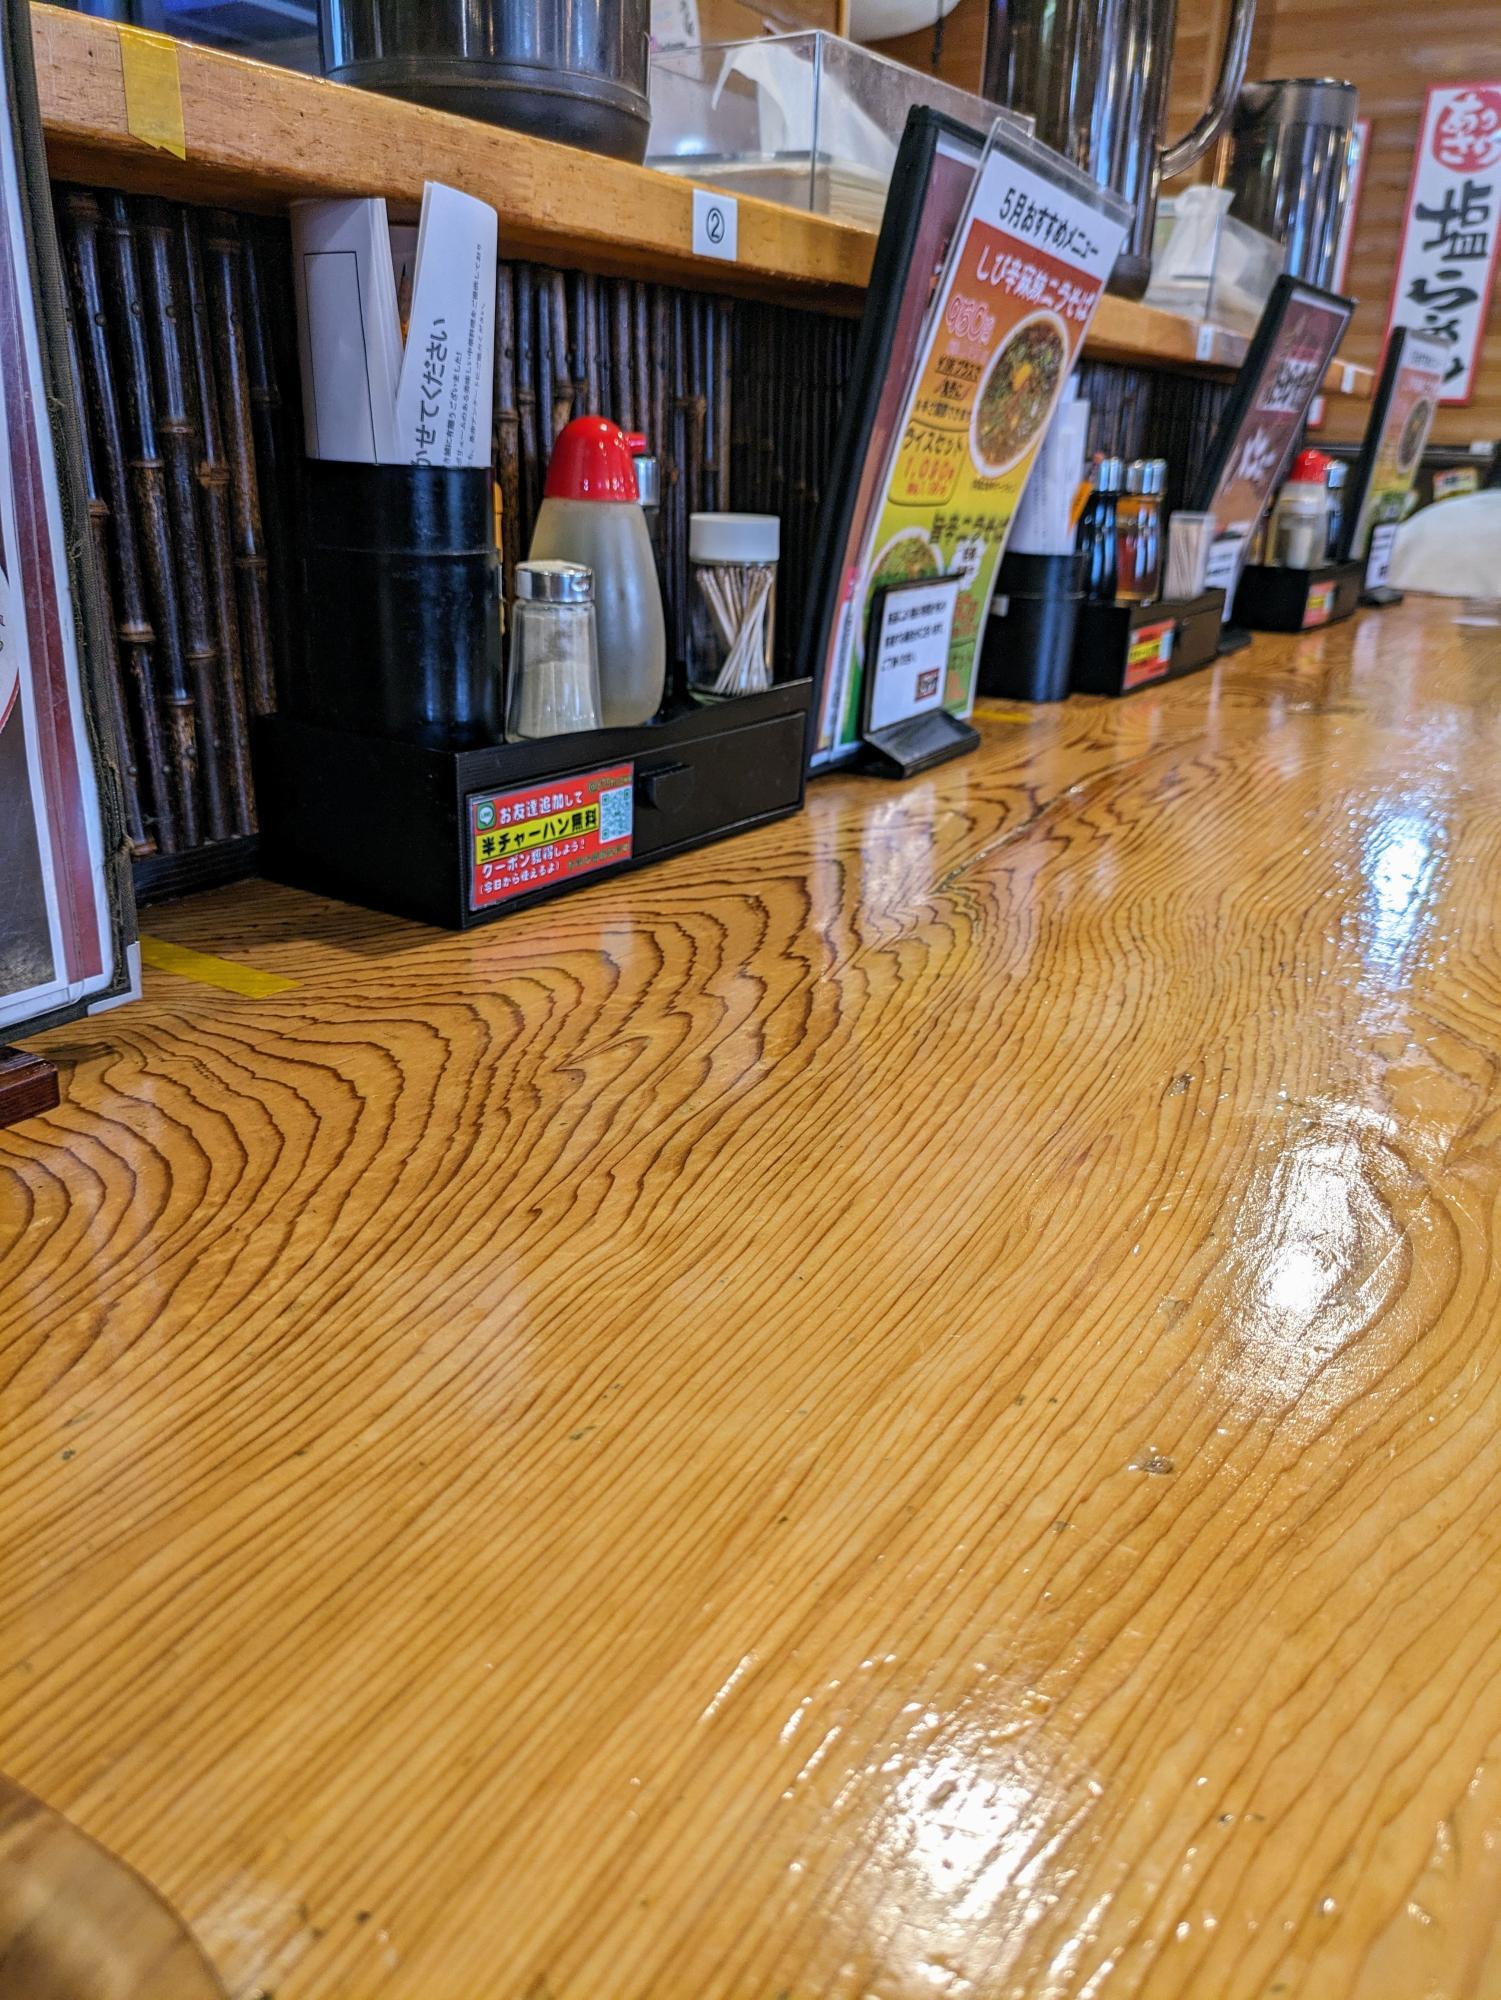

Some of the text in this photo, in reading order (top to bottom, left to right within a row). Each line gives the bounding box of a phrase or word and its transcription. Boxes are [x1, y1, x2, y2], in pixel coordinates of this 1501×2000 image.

[1000, 187, 1099, 259] 5月おすすめメニュー
[500, 791, 584, 824] お友達追加して
[482, 808, 597, 856] 半チャーハン無料
